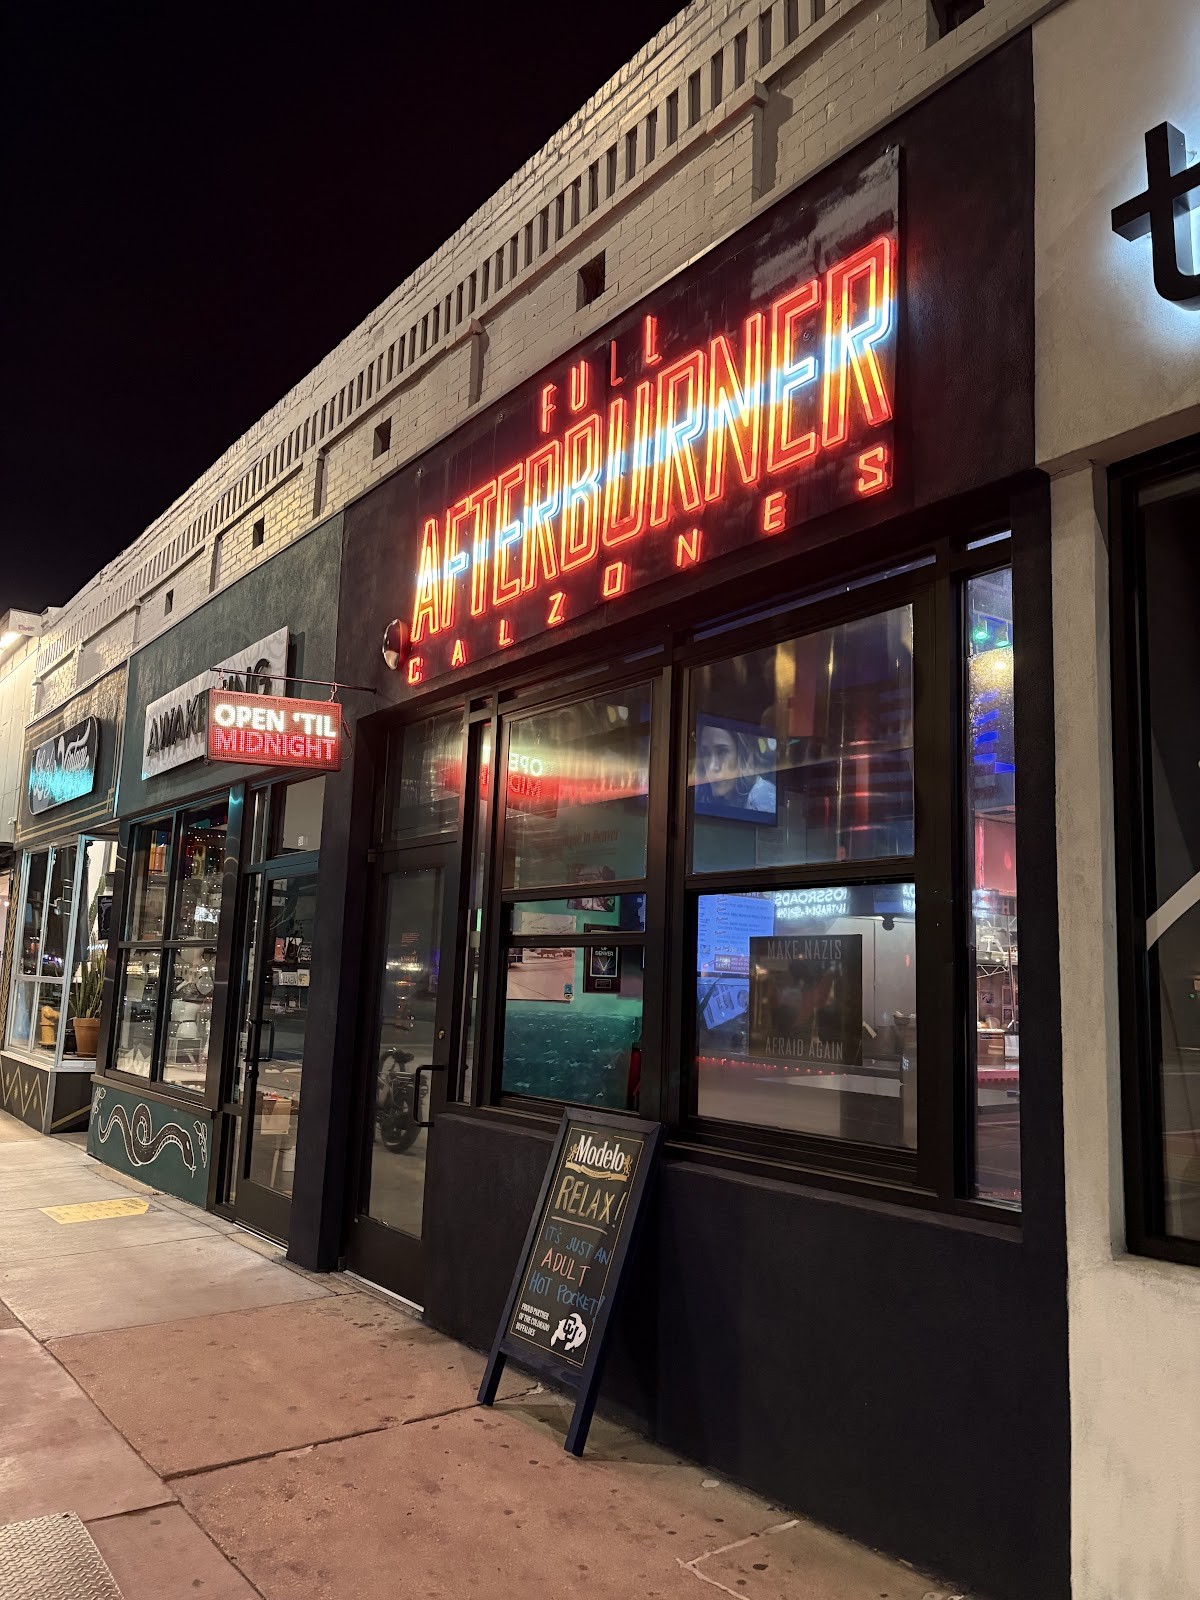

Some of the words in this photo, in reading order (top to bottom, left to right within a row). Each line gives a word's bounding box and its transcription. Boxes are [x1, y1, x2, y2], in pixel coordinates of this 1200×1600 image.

[541, 314, 662, 435] FULL
[410, 235, 893, 644] AFTERBURNER
[406, 446, 889, 685] CALZONES
[213, 703, 285, 732] OPEN
[214, 728, 336, 760] MIDNIGHT
[767, 940, 798, 960] MAKE
[804, 939, 842, 960] NAZIS
[765, 1036, 804, 1057] AFRAID
[808, 1040, 843, 1060] AGAIN
[575, 1135, 625, 1172] Modelo
[545, 1226, 562, 1244] IT'S
[566, 1236, 594, 1259] JUST
[594, 1246, 612, 1266] AN
[529, 1270, 553, 1297] HOT
[540, 1247, 591, 1287] ADULT
